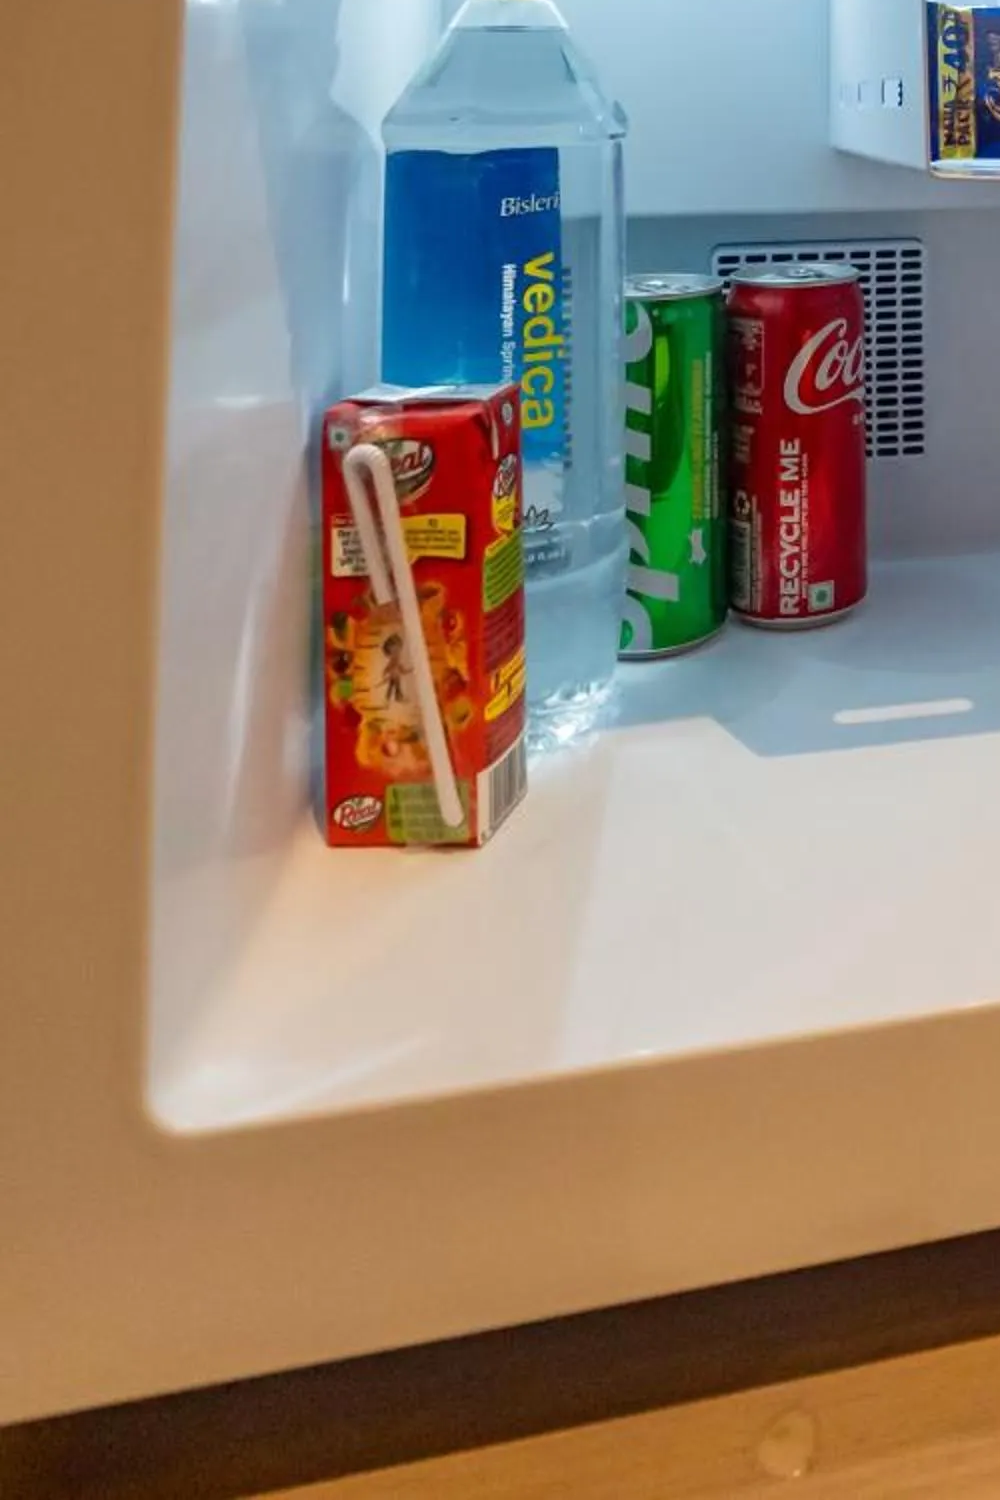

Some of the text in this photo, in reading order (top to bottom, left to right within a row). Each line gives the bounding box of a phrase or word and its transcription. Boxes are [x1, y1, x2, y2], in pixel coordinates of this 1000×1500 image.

[500, 193, 561, 217] Bisleri
[499, 263, 517, 338] Himalayan
[522, 251, 565, 430] vedica
[779, 438, 801, 616] RECYCLE ME
